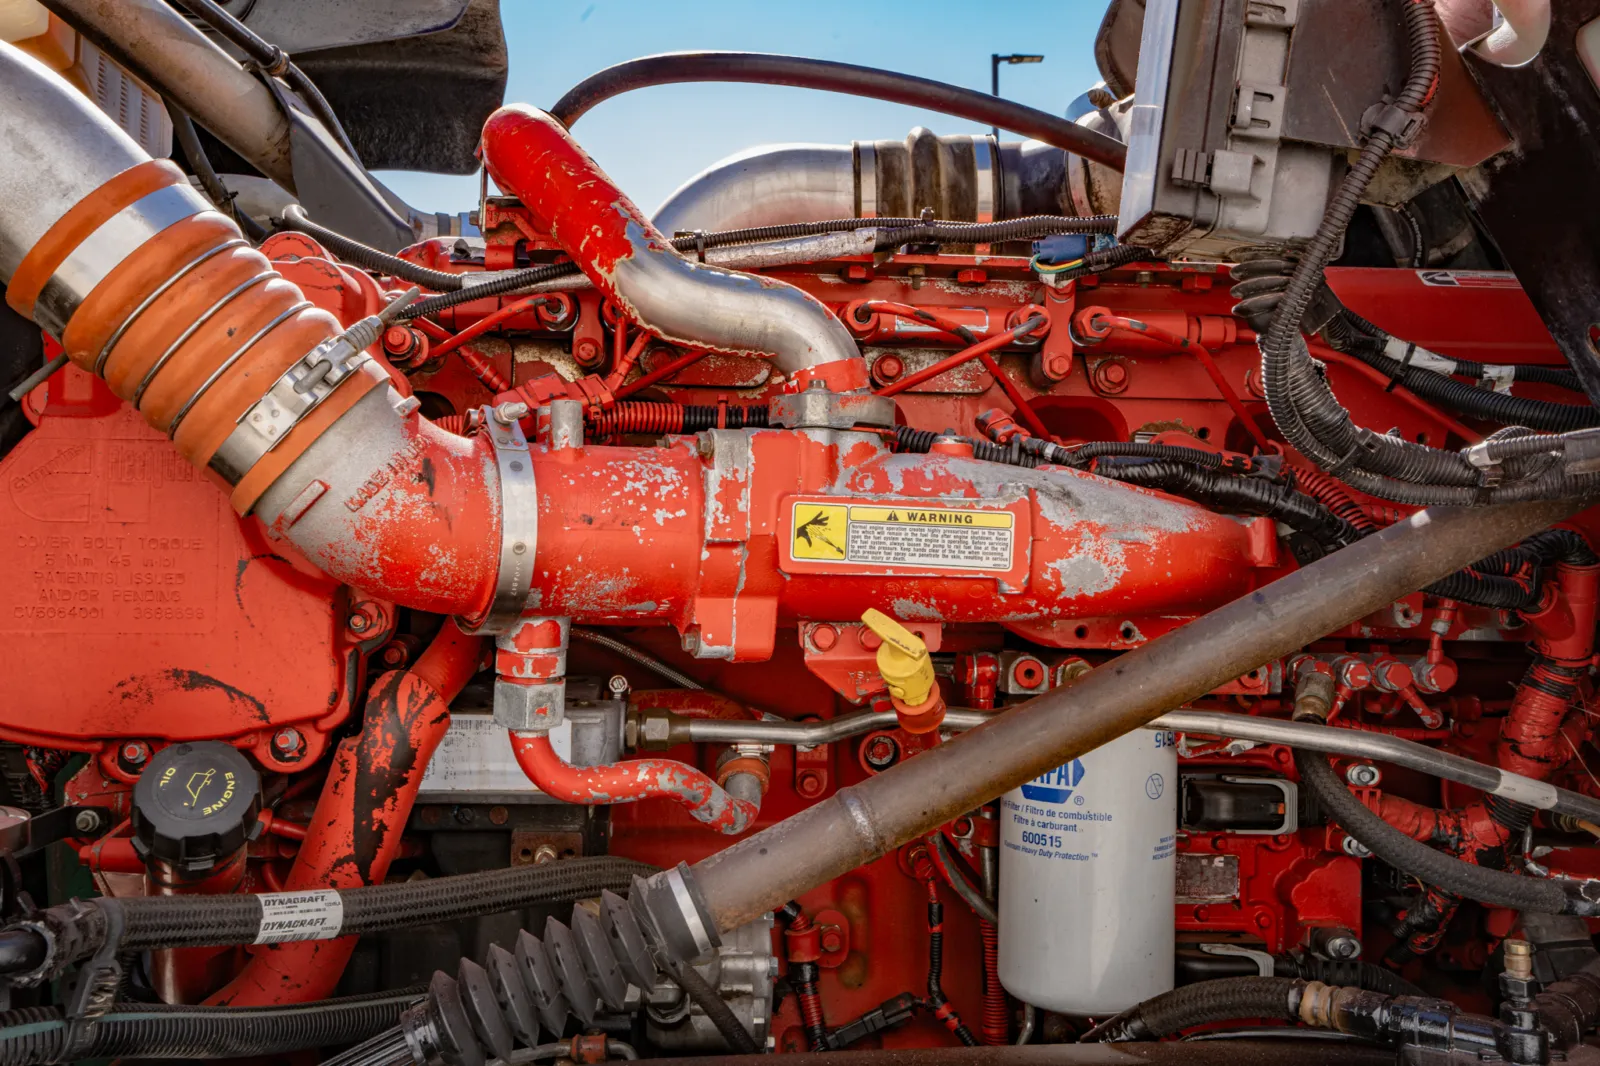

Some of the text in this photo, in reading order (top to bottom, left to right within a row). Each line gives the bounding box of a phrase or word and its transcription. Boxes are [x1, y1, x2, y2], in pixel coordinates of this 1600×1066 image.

[344, 469, 390, 513] MADE
[907, 512, 974, 524] WARNING
[17, 536, 205, 550] COVER BOLT TORQUE
[45, 554, 56, 566] 5
[34, 572, 186, 586] PATENT(S) ISSUED
[39, 590, 182, 604] AND/OR PENDING
[160, 767, 177, 787] OIL
[202, 772, 236, 816] ENGINE
[1025, 805, 1044, 817] Filtro
[1046, 808, 1056, 818] de
[1058, 812, 1113, 822] combustible
[1013, 814, 1030, 826] Filtre
[1037, 820, 1077, 832] carburant
[1022, 830, 1062, 848] 600515
[1021, 846, 1037, 857] Heavy
[1038, 849, 1053, 860] Duty
[1054, 851, 1089, 862] Protection
[264, 894, 326, 906] DYNACRAFT
[262, 918, 327, 931] DYNACRAFT
